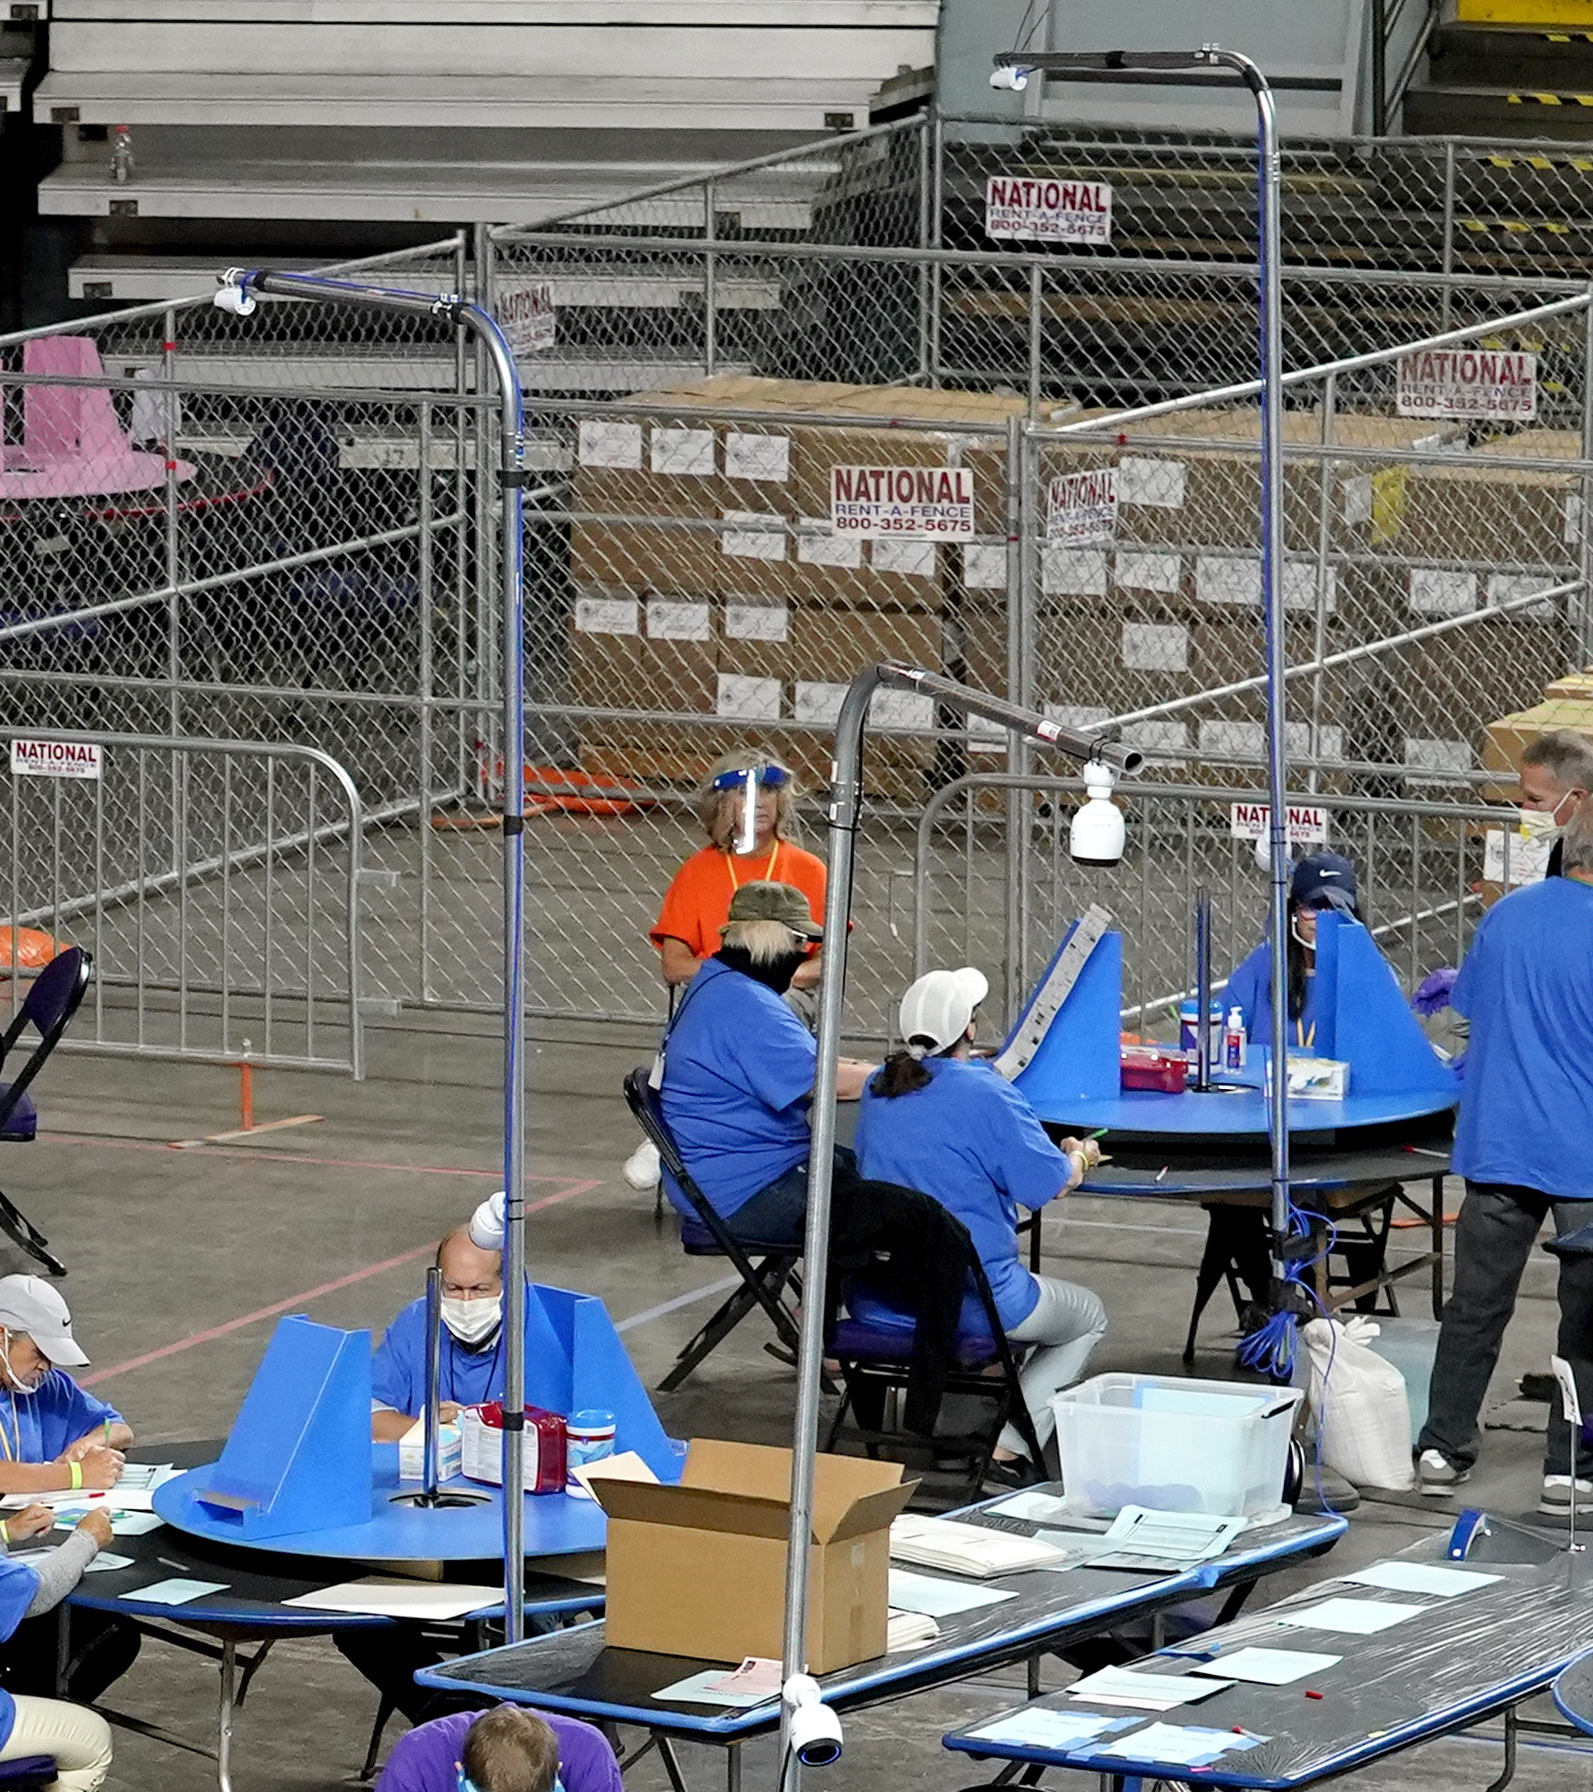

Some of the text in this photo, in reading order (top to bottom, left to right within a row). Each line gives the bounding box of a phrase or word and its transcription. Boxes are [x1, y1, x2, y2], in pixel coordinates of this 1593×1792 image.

[991, 180, 1106, 212] NATIONAL
[1402, 352, 1531, 386] NATIONAL
[835, 468, 971, 504] NATIONAL
[835, 503, 972, 518] RENT-A-FENCE
[836, 517, 971, 532] 800-352-5675
[17, 742, 97, 763] NATIONAL
[1237, 805, 1323, 827] NATNAL
